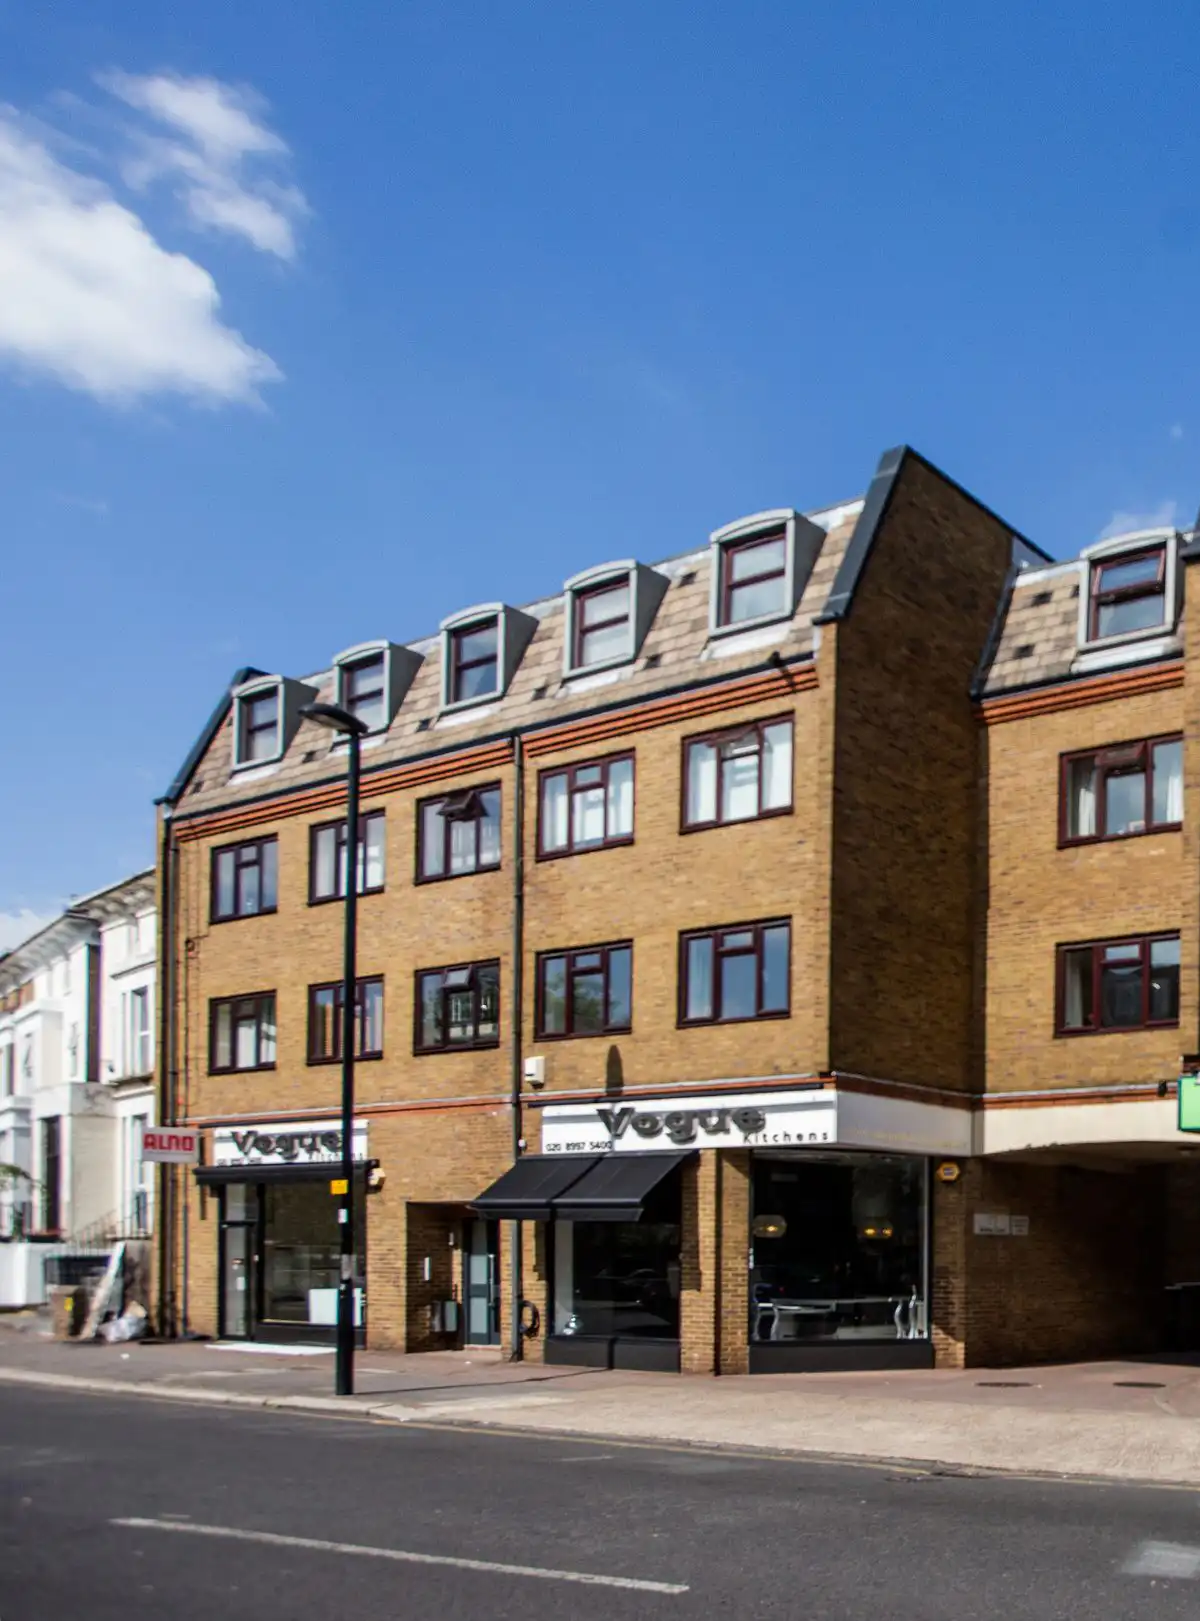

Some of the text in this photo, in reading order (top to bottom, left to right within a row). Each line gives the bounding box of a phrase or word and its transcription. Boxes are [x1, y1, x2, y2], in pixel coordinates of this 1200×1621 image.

[596, 1106, 767, 1145] Vogue
[144, 1134, 195, 1152] ALNO
[230, 1130, 342, 1161] Vogue
[743, 1130, 830, 1144] Kitchens
[545, 1143, 562, 1152] 020
